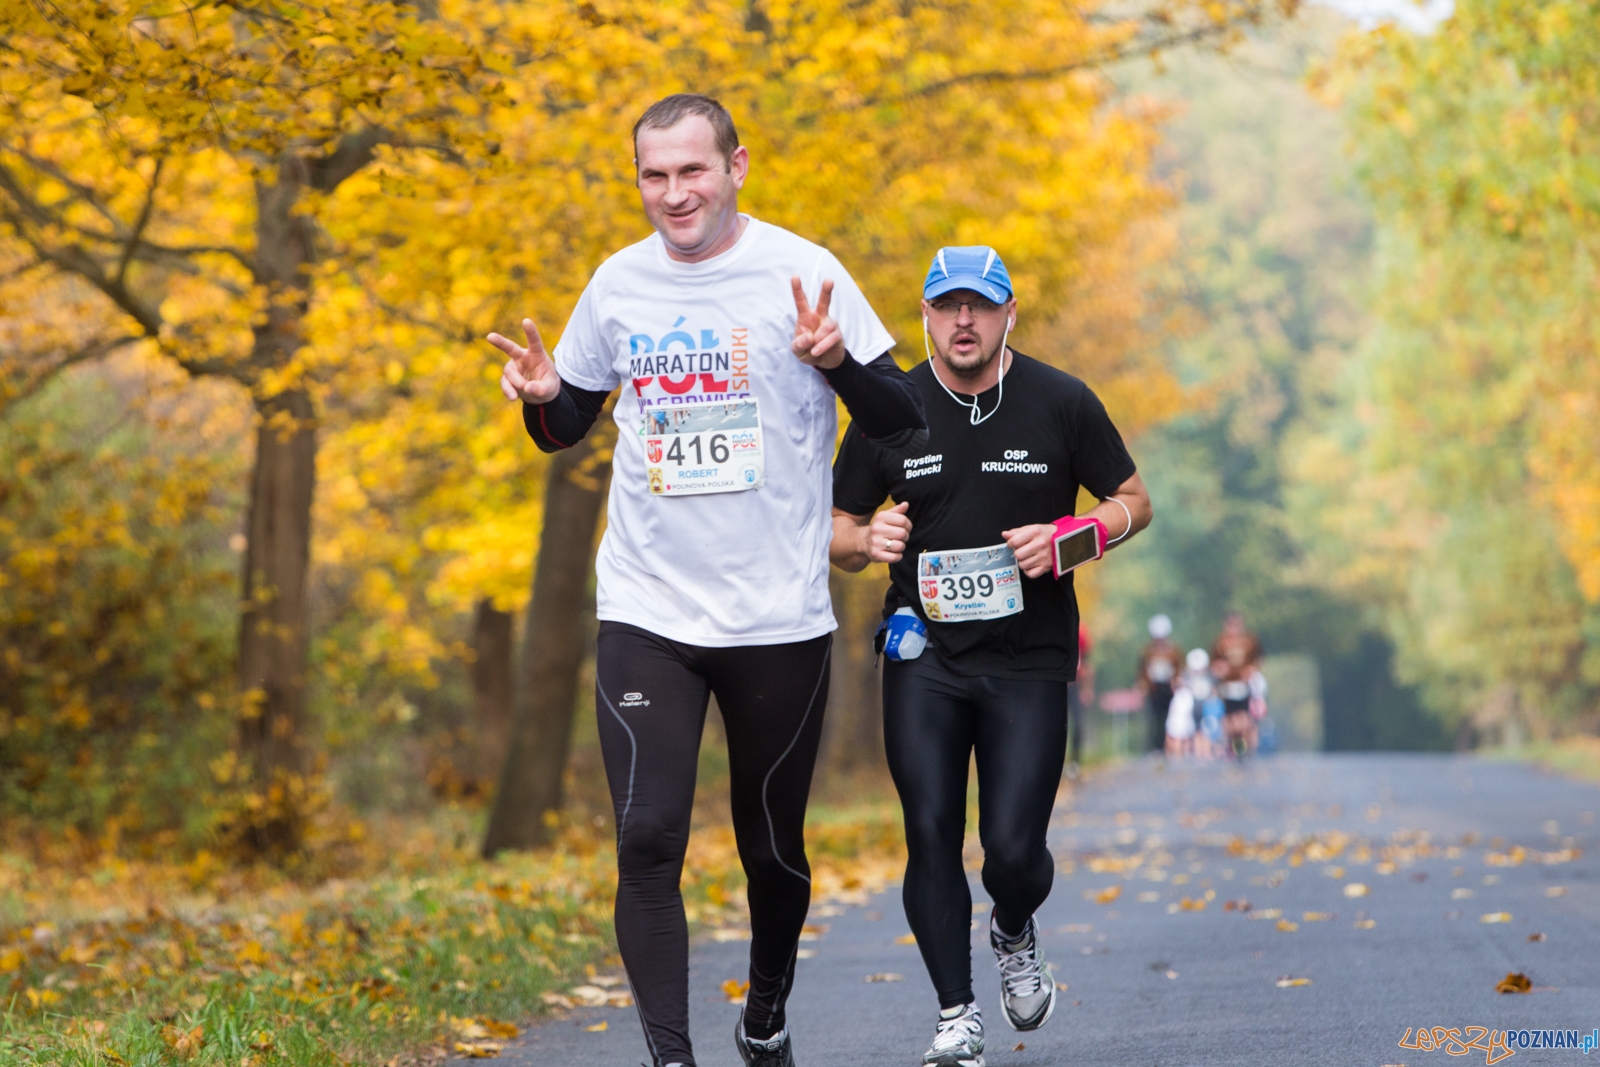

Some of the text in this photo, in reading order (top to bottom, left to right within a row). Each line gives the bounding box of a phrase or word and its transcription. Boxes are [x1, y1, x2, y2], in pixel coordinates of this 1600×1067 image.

[629, 352, 729, 377] MARATON
[731, 327, 749, 391] SKOKI
[666, 433, 730, 466] 416
[1003, 449, 1029, 461] OSP
[903, 453, 943, 469] Krystian
[981, 461, 1048, 474] KRUCHOWO
[678, 468, 719, 479] ROBERT
[905, 463, 942, 480] Borucki
[707, 480, 735, 488] POLSKA
[941, 573, 994, 601] 399
[954, 601, 986, 611] Krystian
